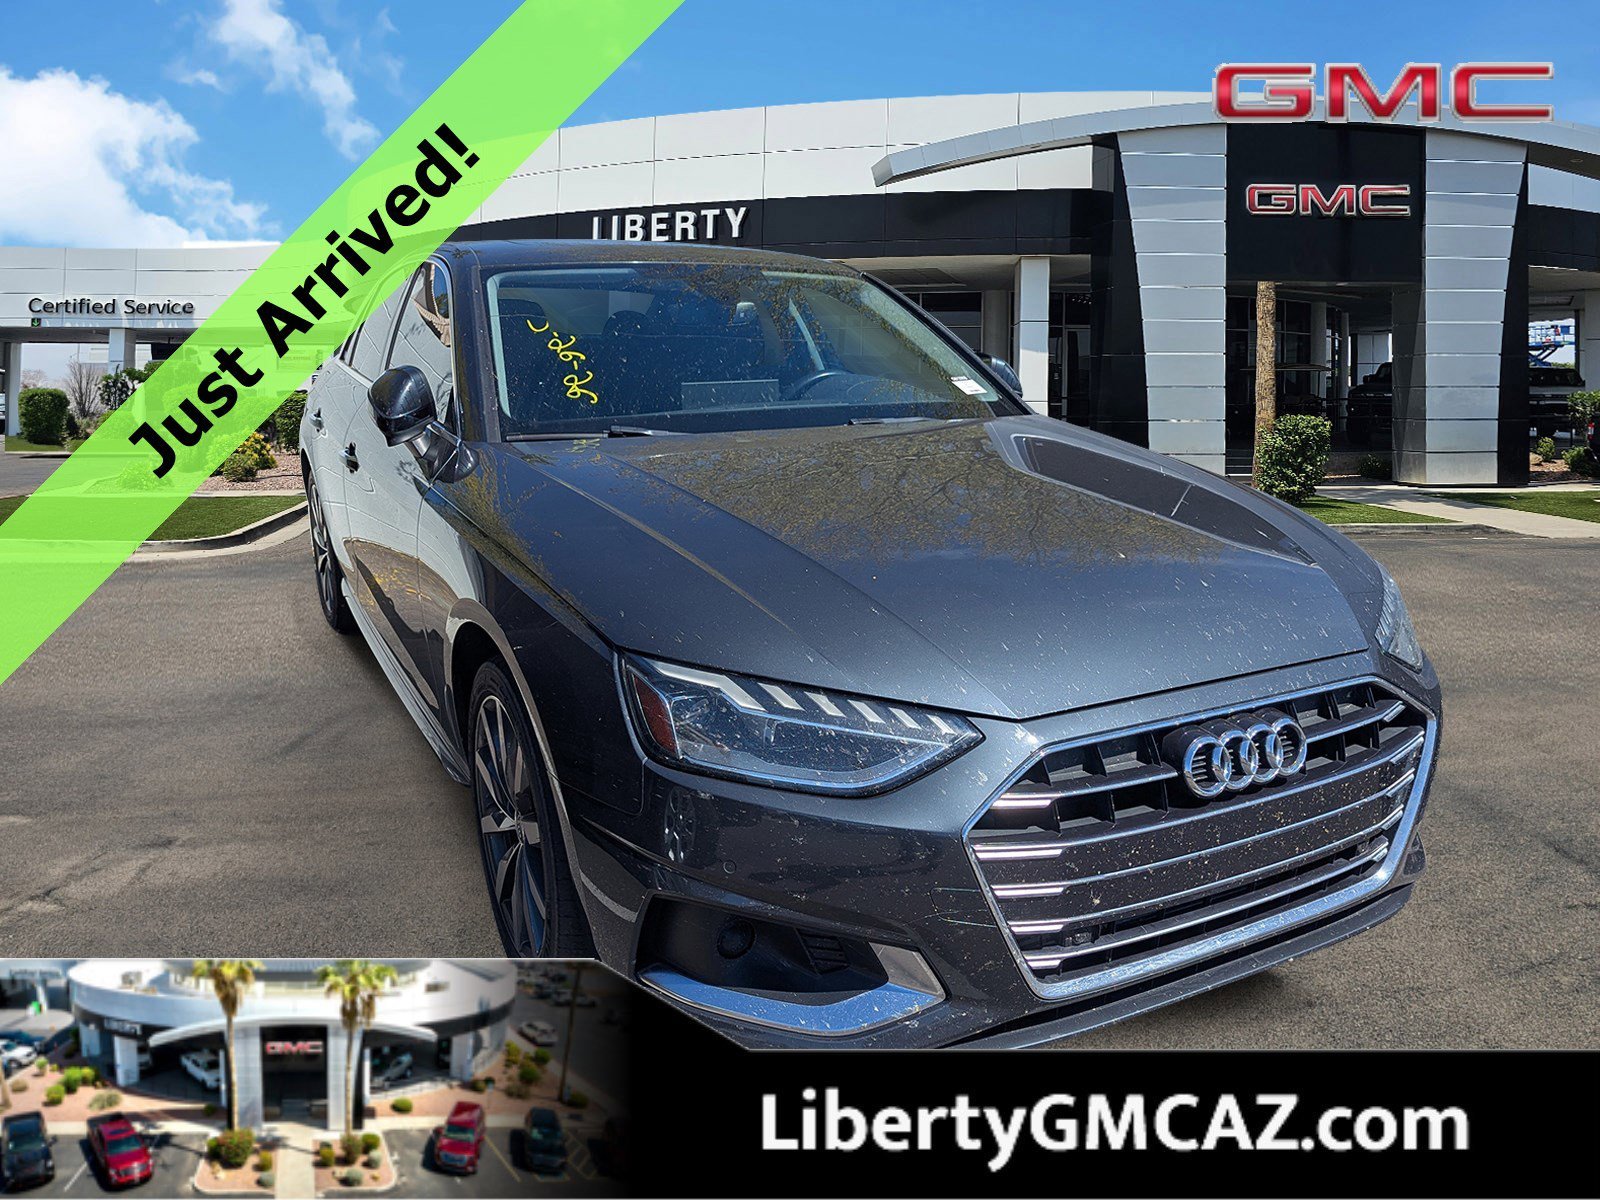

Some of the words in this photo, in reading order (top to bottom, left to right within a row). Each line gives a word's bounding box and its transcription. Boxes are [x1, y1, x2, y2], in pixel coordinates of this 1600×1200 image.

[1245, 184, 1411, 217] GMC
[592, 206, 748, 242] LIBERTY
[28, 297, 116, 315] Certified
[124, 299, 194, 315] Service
